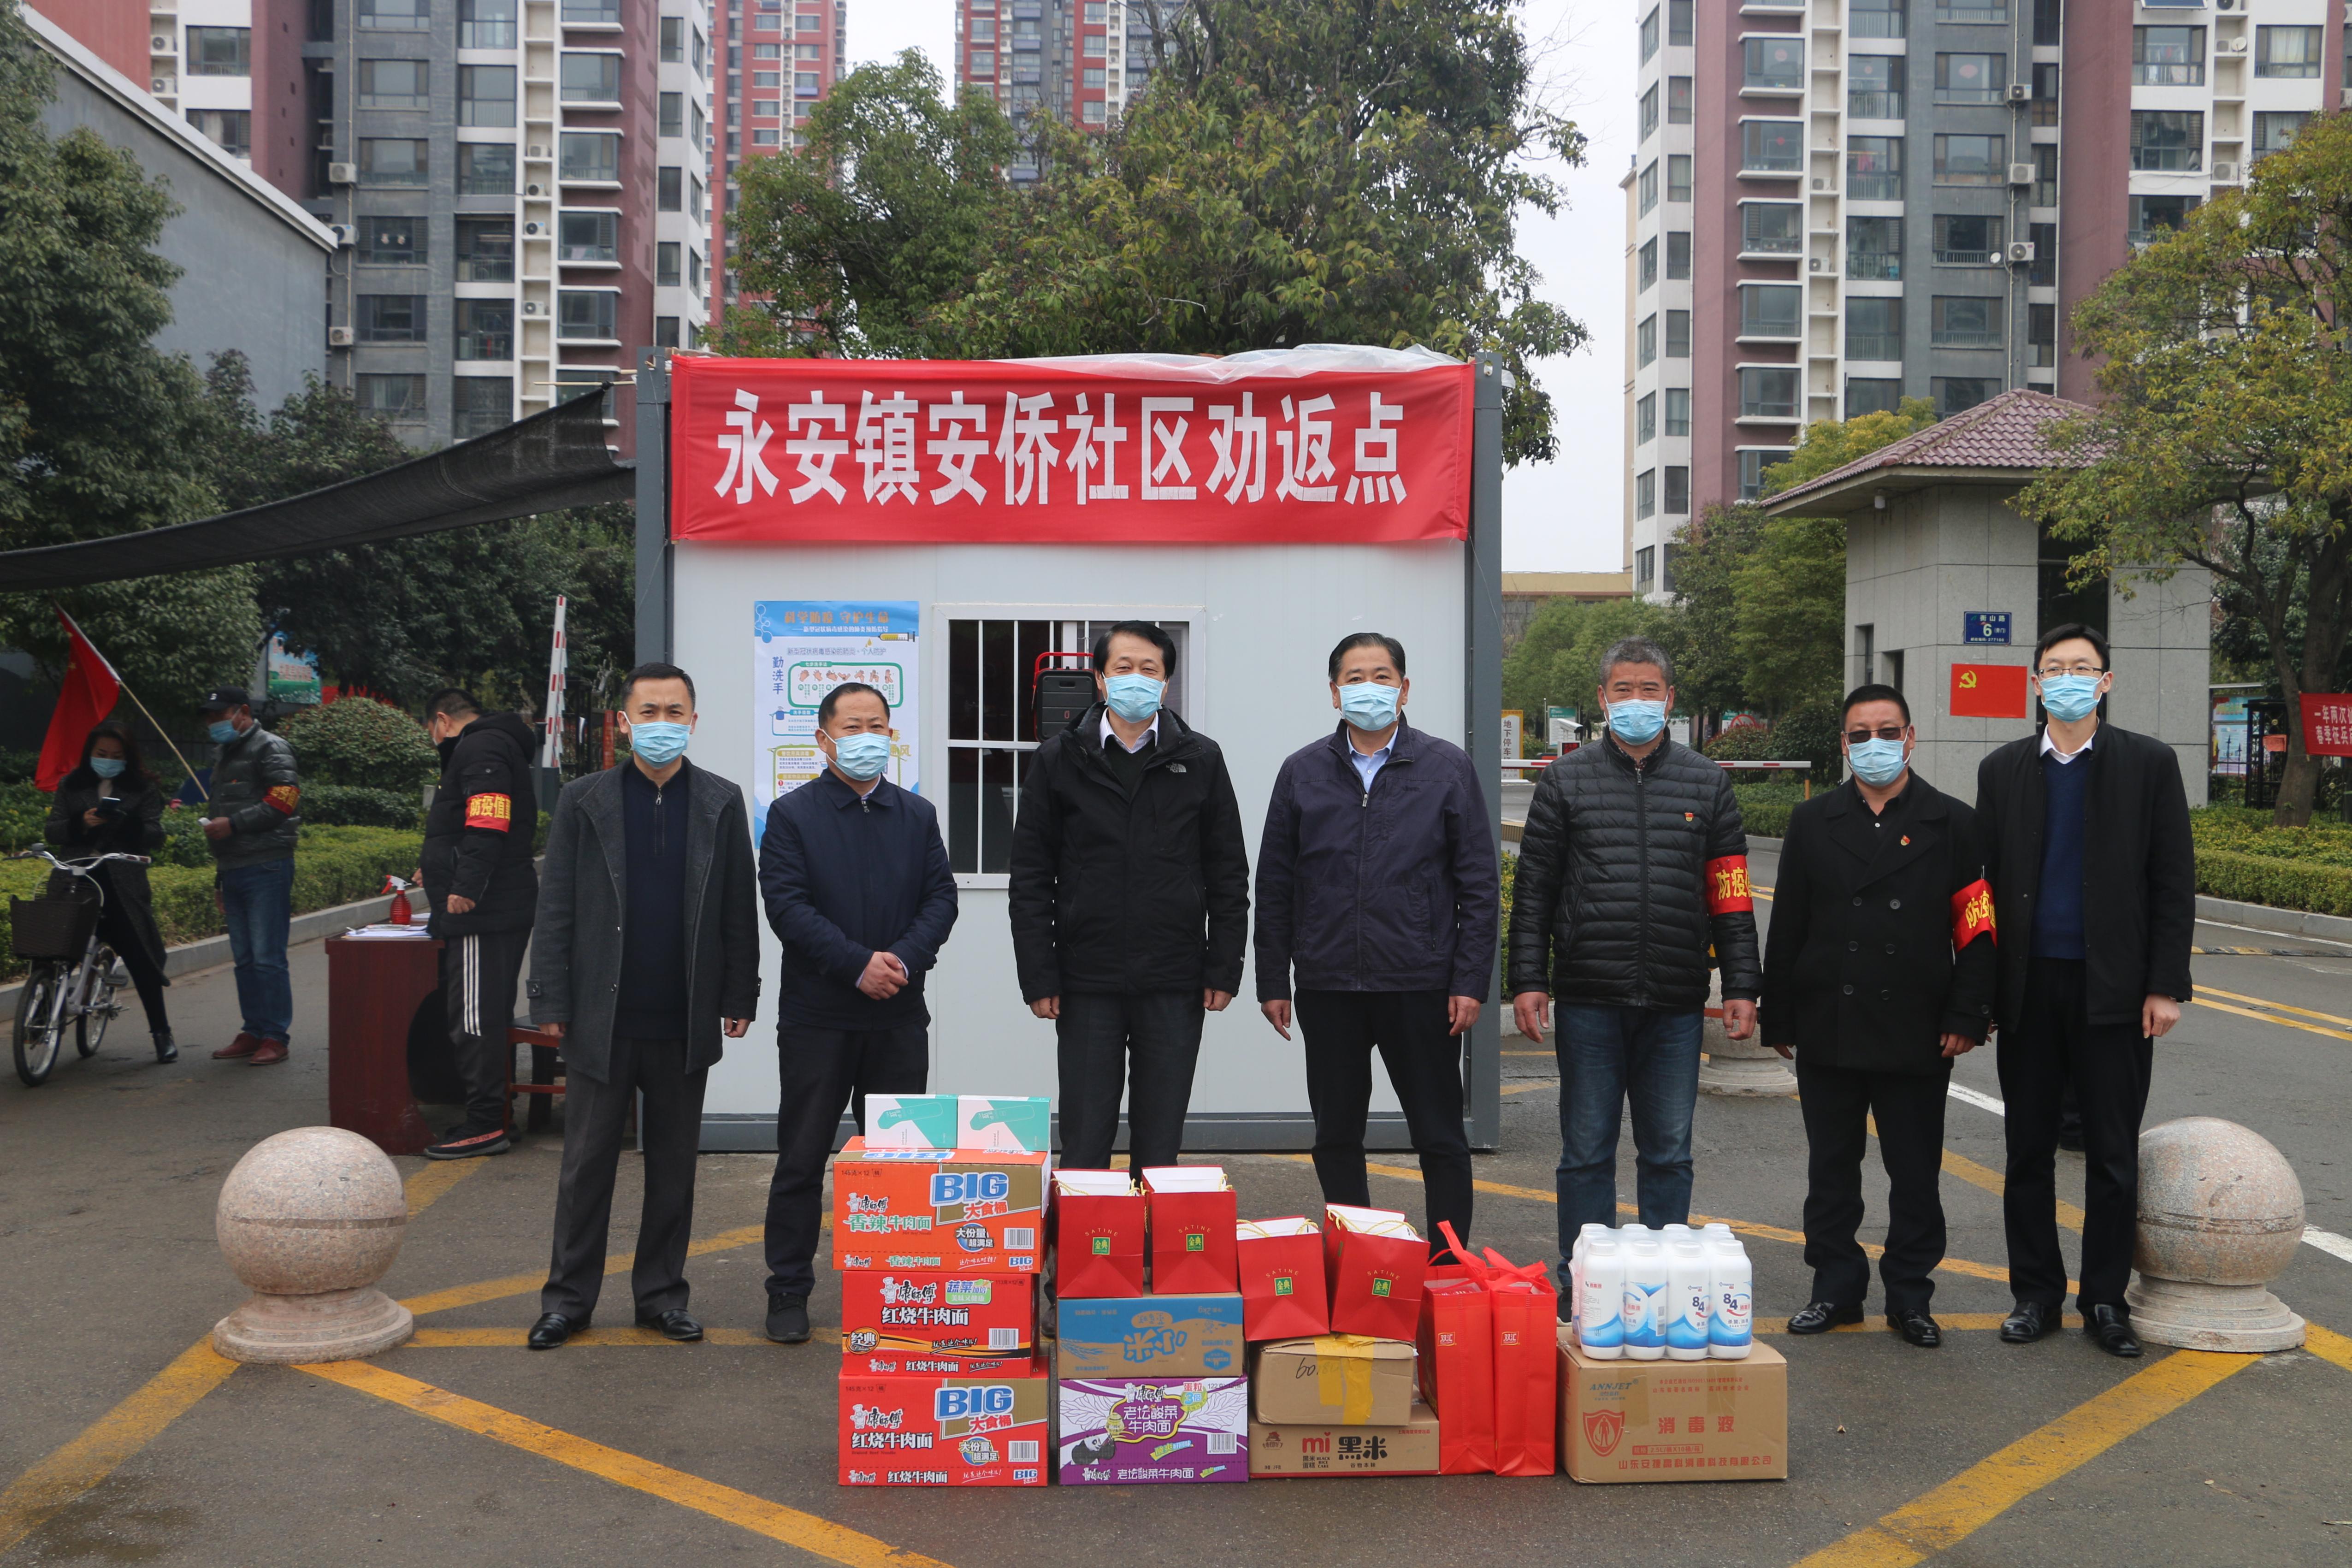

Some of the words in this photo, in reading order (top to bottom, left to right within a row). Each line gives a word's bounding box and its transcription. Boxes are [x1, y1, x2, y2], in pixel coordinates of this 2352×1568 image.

[714, 388, 1407, 506] 永安镇安侨社区劝返点
[785, 611, 833, 624] 科学防疫
[839, 611, 889, 624] 守护生命
[1983, 623, 1992, 637] 6
[772, 656, 784, 694] 勤洗手
[1503, 720, 1512, 759] 地下停车
[931, 1173, 1008, 1205] BIG
[965, 1201, 1008, 1220] 大食桶
[843, 1214, 932, 1233] 香辣牛肉面
[1178, 1225, 1211, 1233] SATINE
[956, 1228, 987, 1238] 大份量
[1085, 1228, 1118, 1236] SATINE
[969, 1239, 993, 1247] 超满足
[1094, 1239, 1108, 1249] 金典
[1188, 1236, 1202, 1246] 金典
[886, 1255, 940, 1268] 香辣牛肉面
[1010, 1257, 1033, 1266] BIG
[1266, 1268, 1299, 1278] SATINE
[1367, 1270, 1401, 1280] SATINE
[946, 1280, 987, 1294] 蔬菜加倍
[1276, 1280, 1290, 1290] 金典
[1375, 1281, 1389, 1291] 金典
[899, 1281, 936, 1303] 康師傅
[1692, 1296, 1705, 1312] 84
[1723, 1293, 1738, 1310] 84
[881, 1307, 969, 1325] 红烧牛肉面
[851, 1332, 876, 1345] 经典
[905, 1360, 959, 1372] 红烧牛肉面
[1183, 1382, 1203, 1392] 蛋粒
[936, 1388, 1012, 1420] BIG
[1184, 1392, 1202, 1405] 3倍
[868, 1408, 902, 1428] 康師傅
[1123, 1405, 1178, 1420] 老坛酸菜
[969, 1414, 1012, 1434] 大食桶
[1128, 1420, 1171, 1433] 牛肉面
[1658, 1416, 1734, 1434] 消毒液
[851, 1432, 933, 1449] 红烧牛肉面
[961, 1442, 991, 1452] 大份量
[1302, 1432, 1331, 1453] mi
[1338, 1435, 1388, 1460] 黑米
[973, 1452, 998, 1461] 超满足
[887, 1471, 948, 1483] 红烧牛肉面
[1015, 1469, 1037, 1479] BIG
[1117, 1467, 1194, 1480] 老坛酸菜牛肉面
